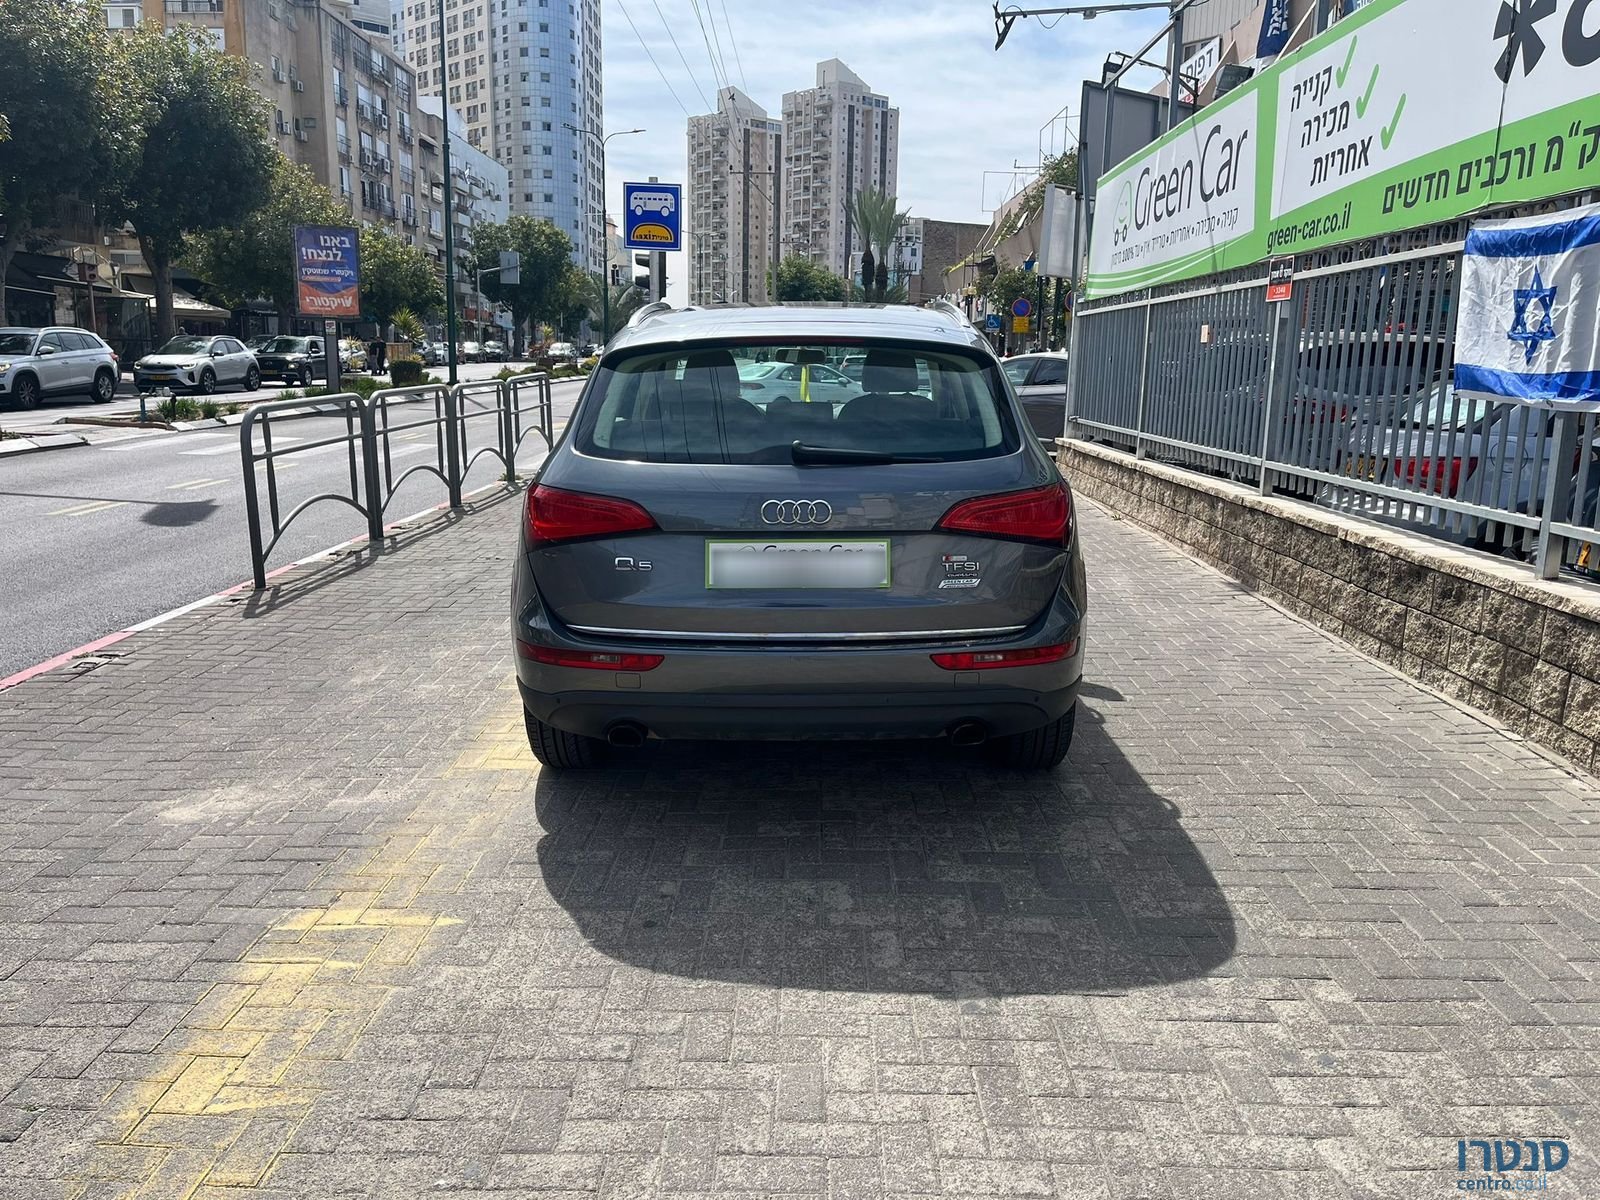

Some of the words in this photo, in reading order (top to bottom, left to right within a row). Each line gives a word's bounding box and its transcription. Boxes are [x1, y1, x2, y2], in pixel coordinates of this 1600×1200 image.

[1186, 48, 1213, 83] דפוס
[1290, 66, 1333, 112] קנייה
[1301, 101, 1350, 148] מכירה
[1135, 159, 1194, 231] Green
[1200, 124, 1248, 203] Car
[1310, 135, 1373, 187] אחריות
[1455, 142, 1537, 196] ורכבים
[1382, 169, 1450, 214] חדשים
[1169, 225, 1191, 246] אחריות
[1195, 216, 1215, 237] מכירה
[1221, 208, 1239, 230] קניה
[1266, 201, 1352, 255] green-car.co.il
[301, 247, 342, 260] לנצח!
[320, 235, 351, 248] באנו
[615, 557, 652, 570] Q5
[942, 561, 979, 571] TFSI
